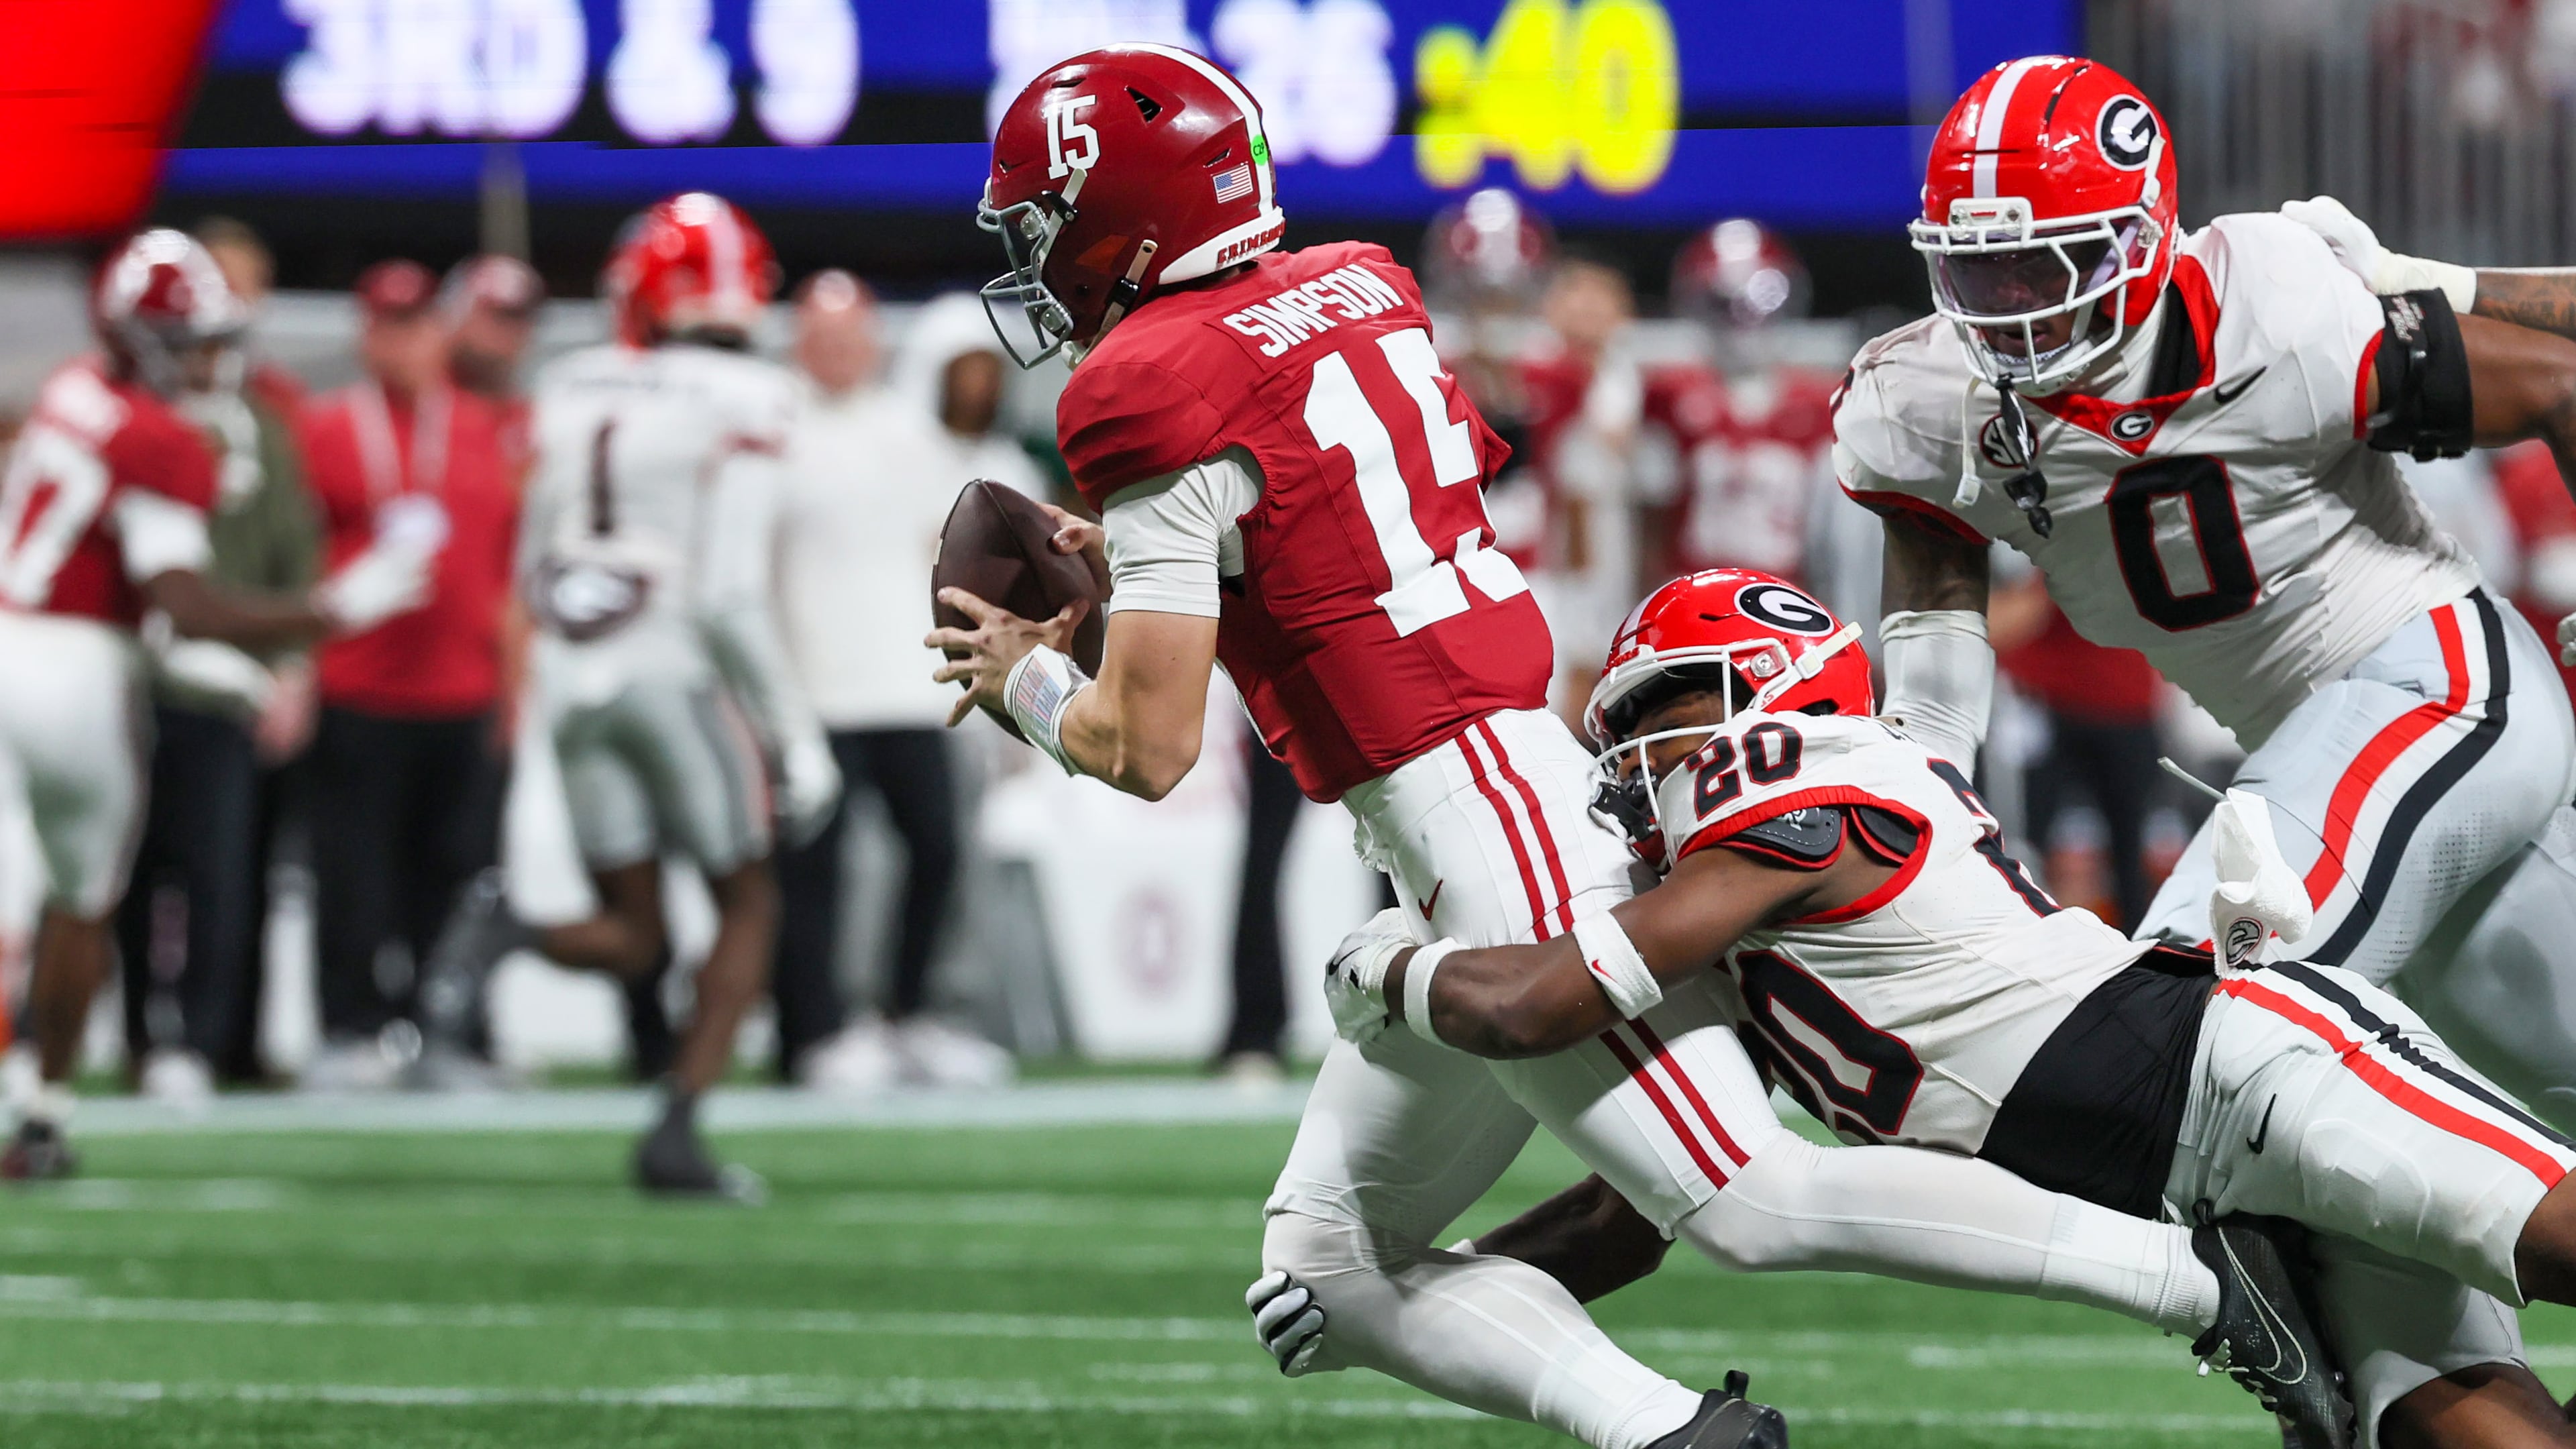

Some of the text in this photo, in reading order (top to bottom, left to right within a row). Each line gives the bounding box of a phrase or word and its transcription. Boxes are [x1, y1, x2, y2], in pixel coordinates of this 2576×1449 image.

[1044, 95, 1101, 180] 15
[2098, 96, 2159, 169] G
[1223, 263, 1404, 358] SIMPSON
[2109, 411, 2155, 441] G
[1302, 327, 1530, 638] 15
[2105, 455, 2261, 633] 0
[1737, 583, 1834, 635] G
[1685, 721, 1803, 820] 20
